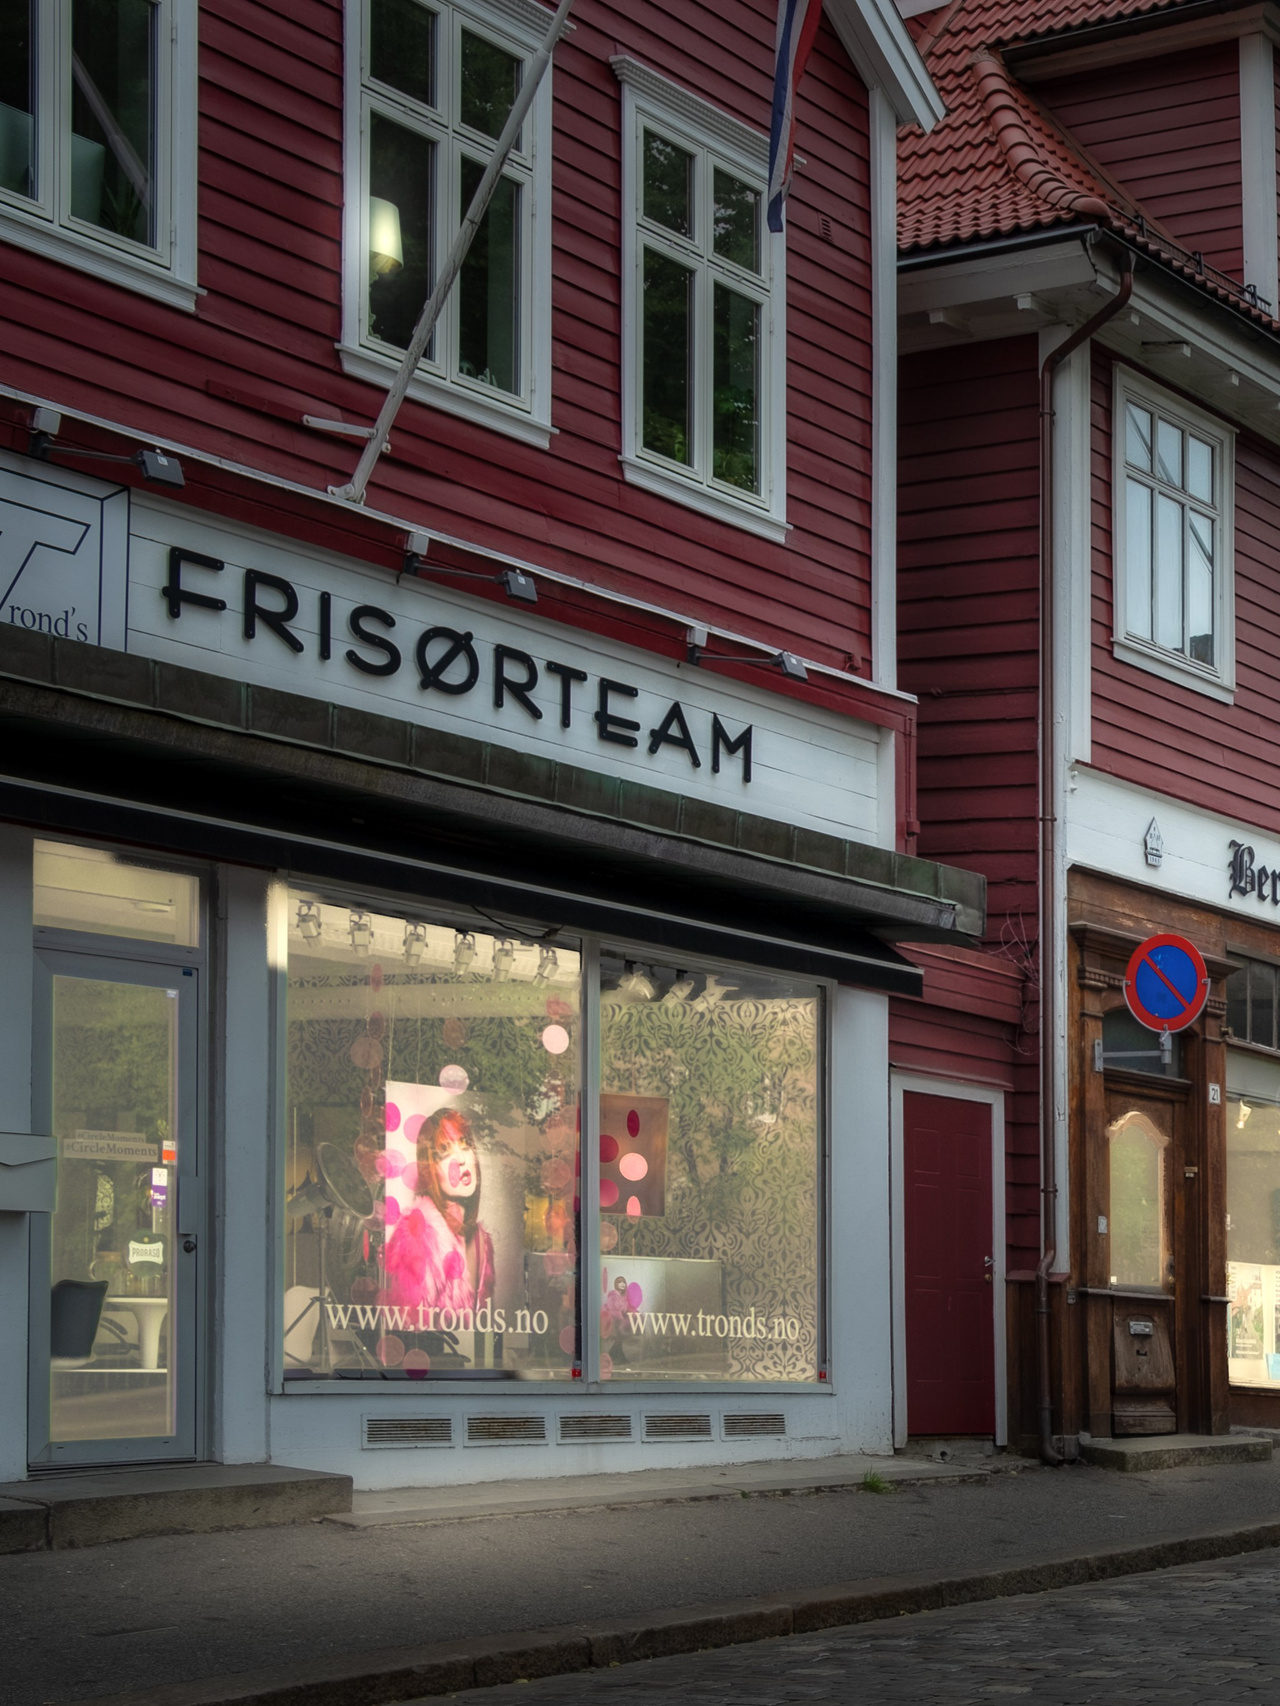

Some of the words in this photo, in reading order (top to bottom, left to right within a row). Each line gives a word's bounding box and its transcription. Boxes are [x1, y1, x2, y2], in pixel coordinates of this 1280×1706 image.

[161, 545, 754, 784] FRISØRTEAM
[1211, 1087, 1219, 1102] 21
[324, 1297, 549, 1335] www.tronds.no
[627, 1306, 799, 1341] www.tronds.no
